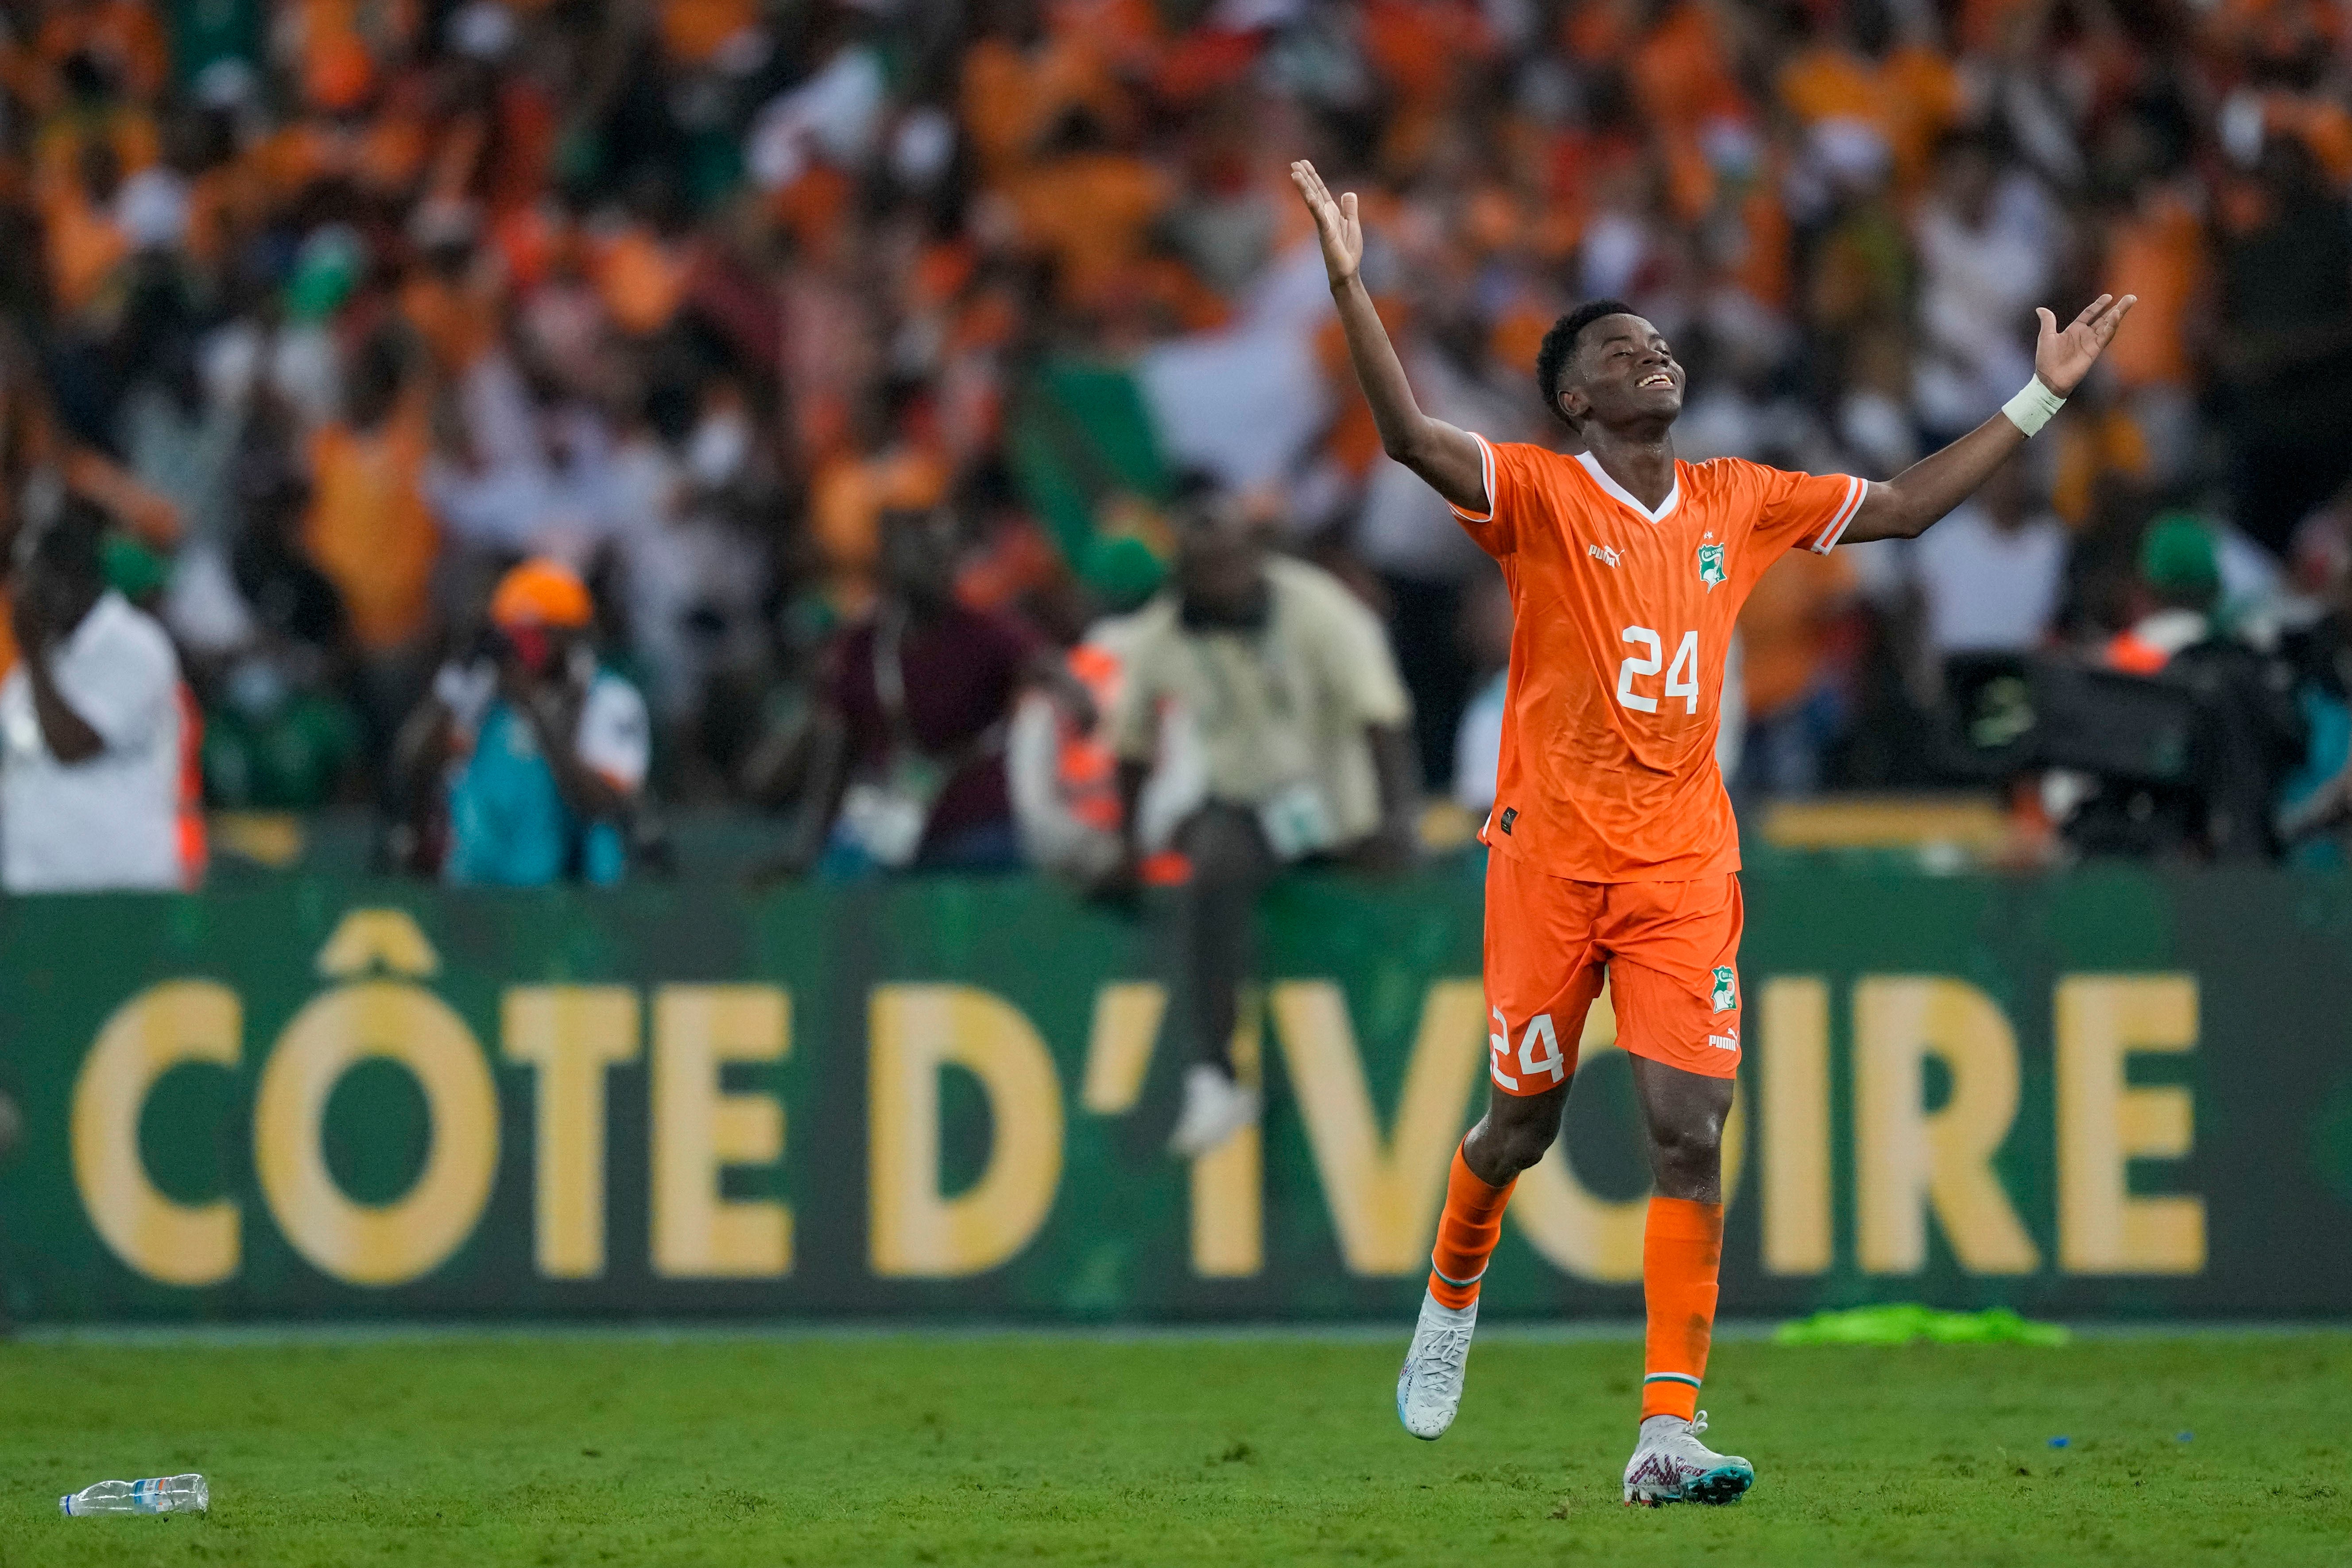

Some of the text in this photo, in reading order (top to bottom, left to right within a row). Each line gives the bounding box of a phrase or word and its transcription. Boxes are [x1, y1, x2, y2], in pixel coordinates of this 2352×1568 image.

[1588, 544, 1616, 569] PUMA
[1616, 625, 1699, 715] 24
[1490, 1004, 1564, 1091] 24
[1709, 1034, 1736, 1052] PUMA
[71, 909, 794, 1284] CÔTE
